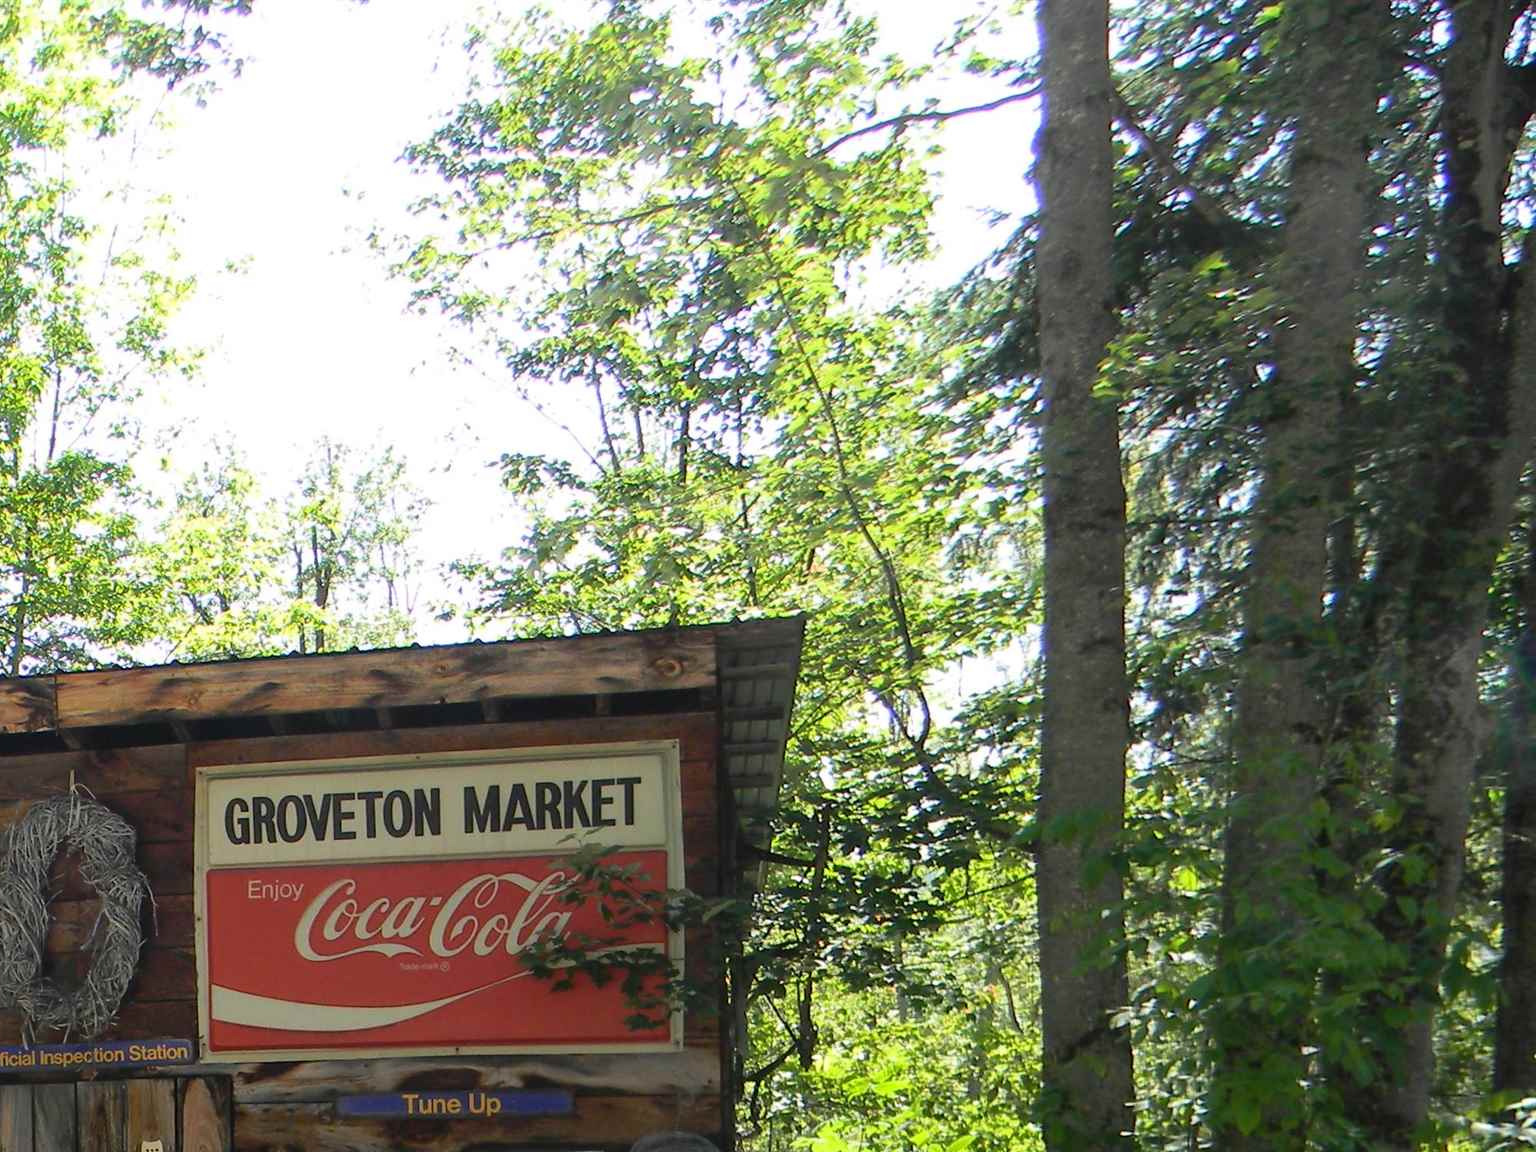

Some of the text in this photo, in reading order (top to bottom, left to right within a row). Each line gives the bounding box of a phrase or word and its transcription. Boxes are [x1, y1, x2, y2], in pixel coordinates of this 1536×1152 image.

[224, 776, 642, 845] GROVETON MARKET
[247, 871, 581, 962] Enjoy Coca-Cola
[39, 1048, 125, 1067] Inspection
[128, 1044, 189, 1063] Station
[401, 1092, 502, 1117] Tune Up
